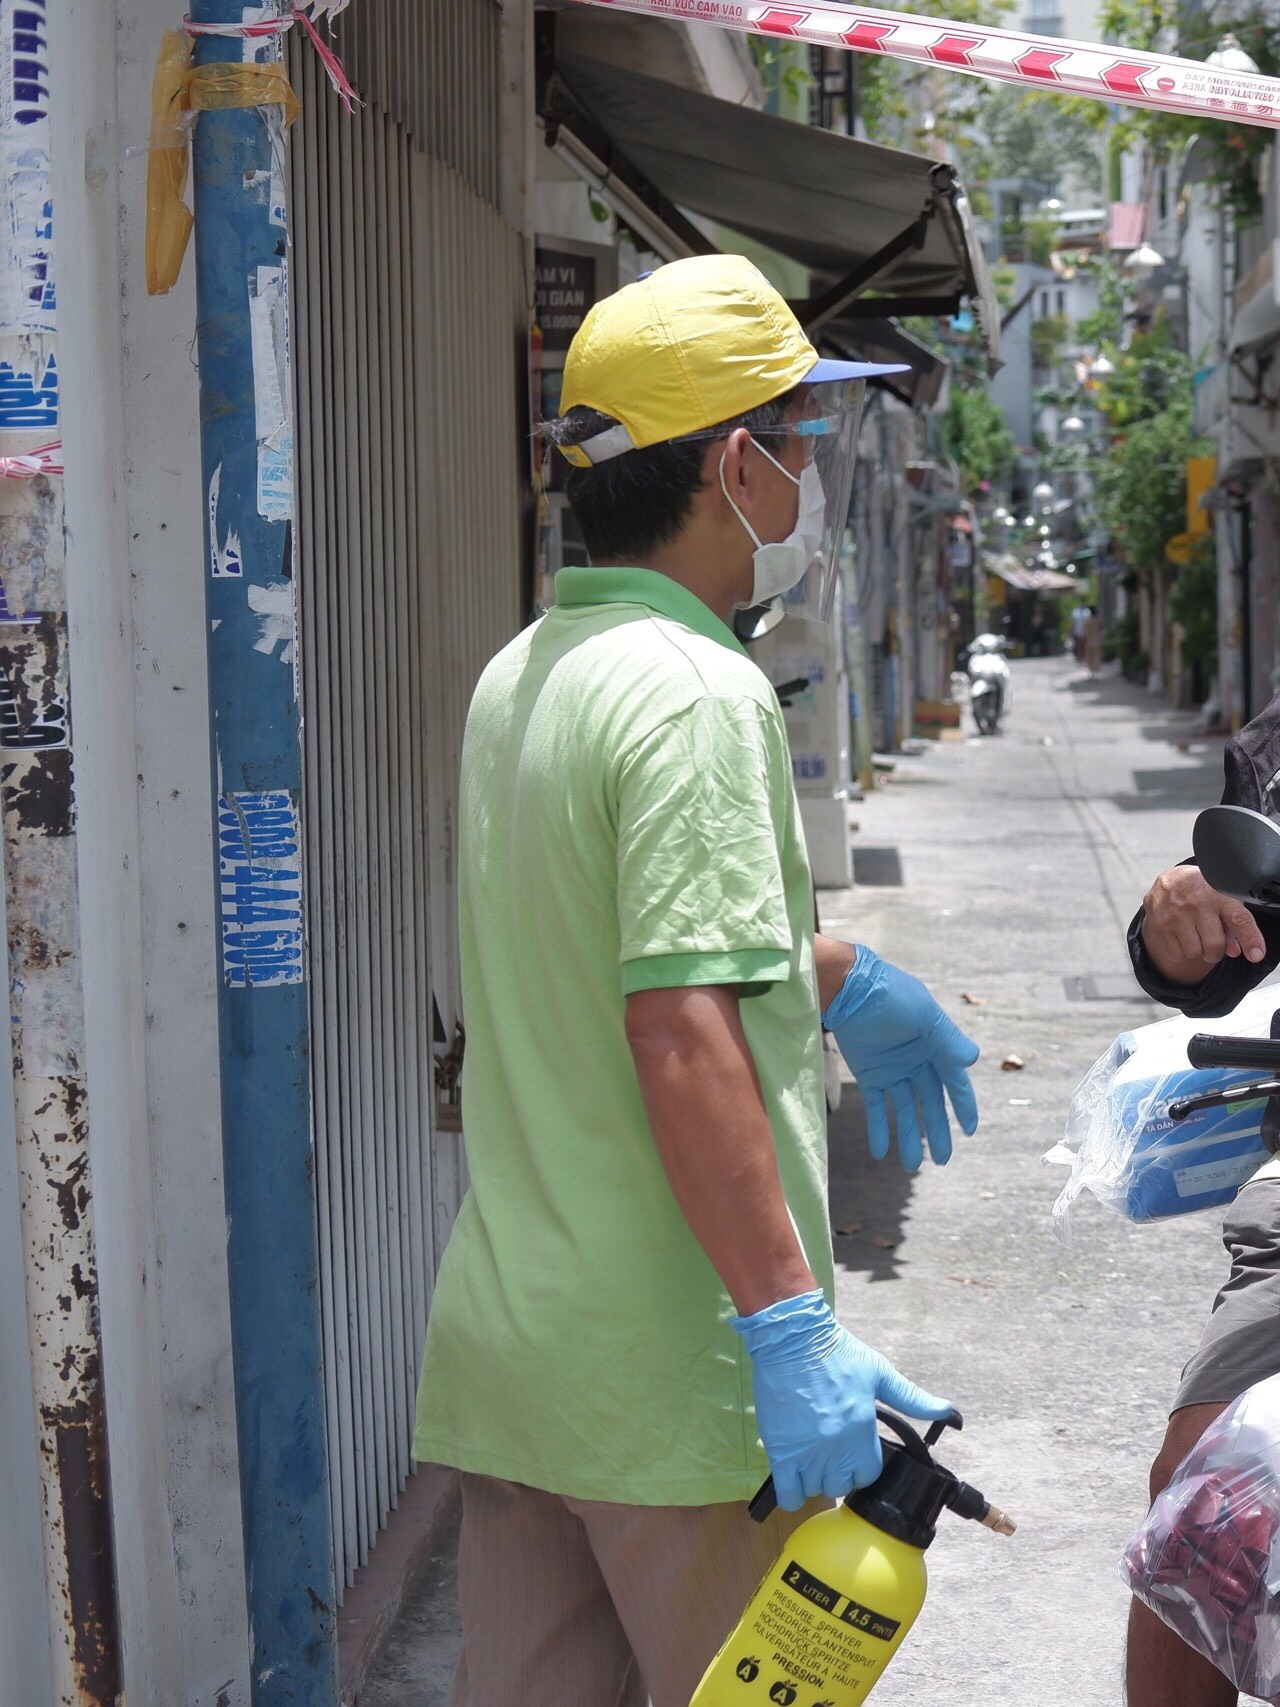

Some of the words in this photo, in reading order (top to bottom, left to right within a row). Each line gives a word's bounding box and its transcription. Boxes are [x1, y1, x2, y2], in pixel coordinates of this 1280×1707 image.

[788, 1570, 802, 1585] 2
[801, 1583, 832, 1606] LITER
[765, 1600, 812, 1637] HOGEDRUK
[811, 1632, 876, 1669] PLANTENSPUIT
[772, 1589, 815, 1624] PRESSURE
[817, 1620, 862, 1649] SPRAYER
[846, 1606, 872, 1627] 4.5
[871, 1620, 895, 1639] PINTS
[758, 1611, 811, 1652] HOCHDRUCK
[810, 1646, 851, 1673] SPRITZE
[771, 1652, 826, 1690] PRESSION.
[831, 1672, 860, 1690] HAUTE
